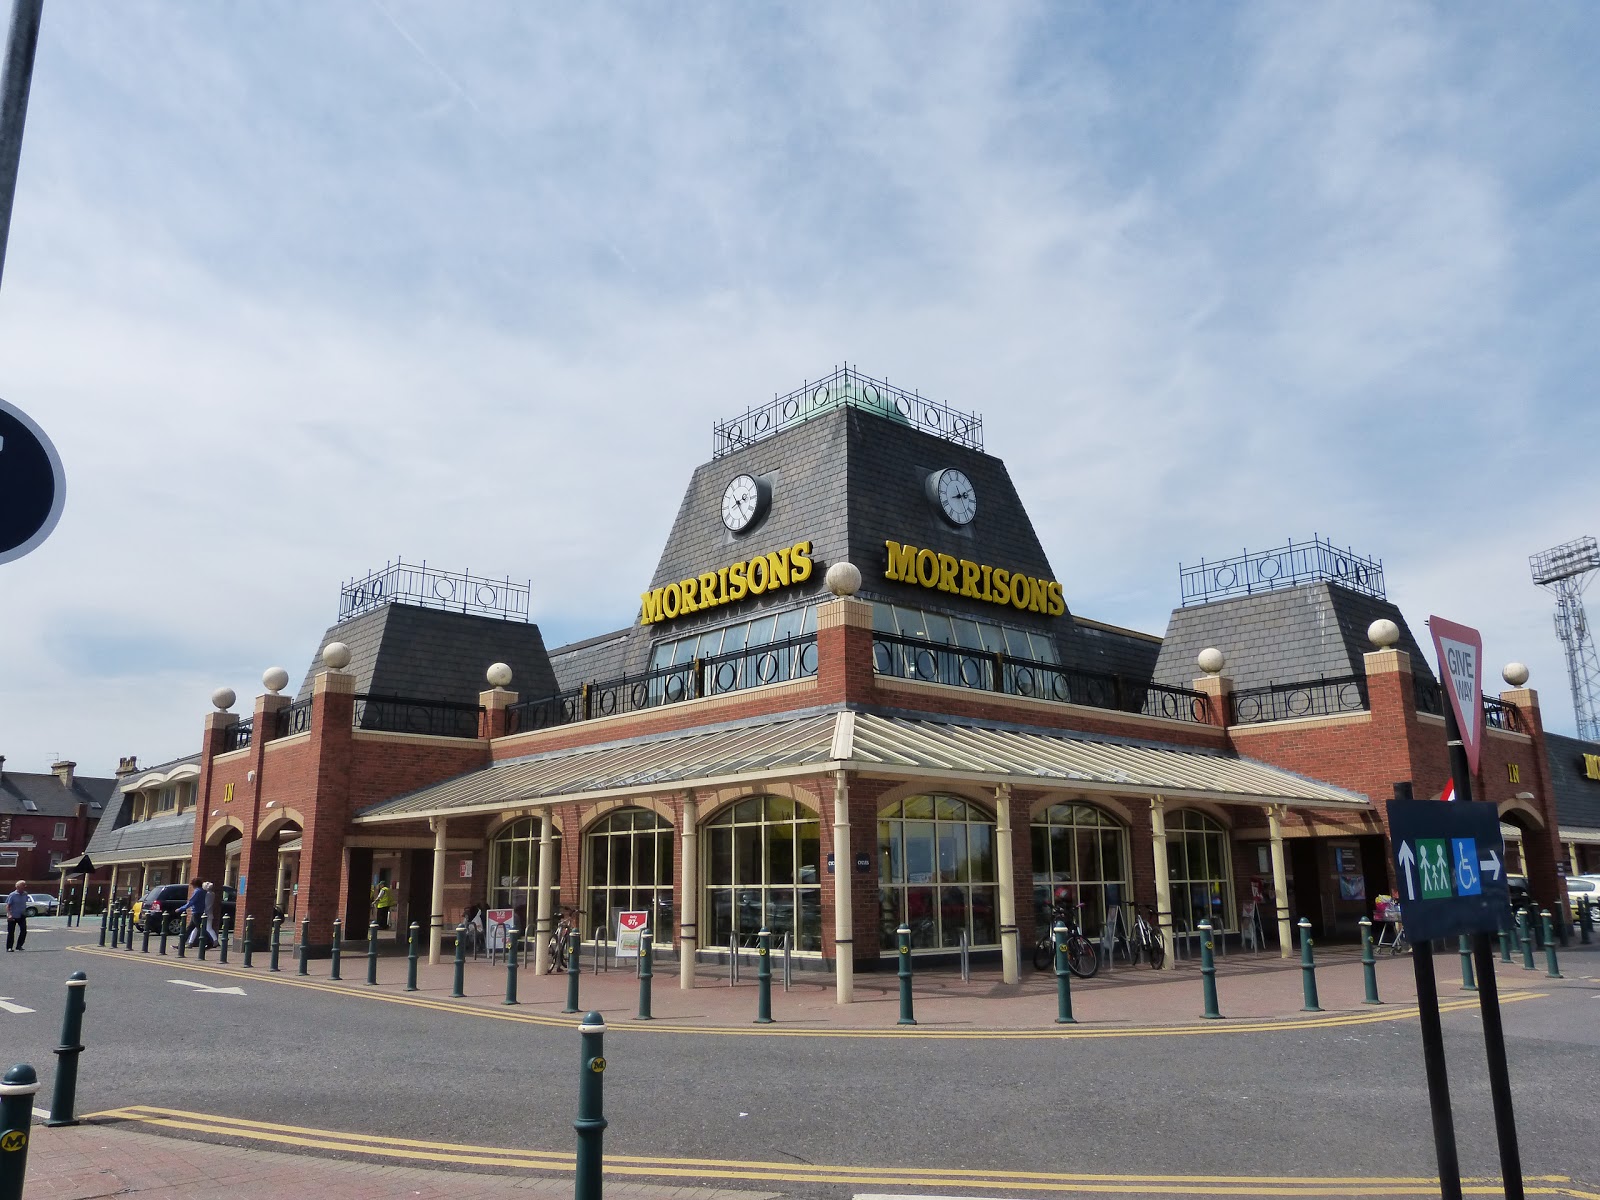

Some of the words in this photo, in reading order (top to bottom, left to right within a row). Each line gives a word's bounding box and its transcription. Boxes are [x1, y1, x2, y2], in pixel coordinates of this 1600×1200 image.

[640, 541, 813, 626] MORRISONS
[885, 540, 1065, 616] MORRISONS
[1447, 647, 1474, 679] GIVE
[1455, 679, 1473, 702] WAY
[1507, 763, 1520, 783] IN
[224, 783, 235, 802] IN
[593, 1061, 604, 1069] M
[4, 1134, 24, 1147] M
